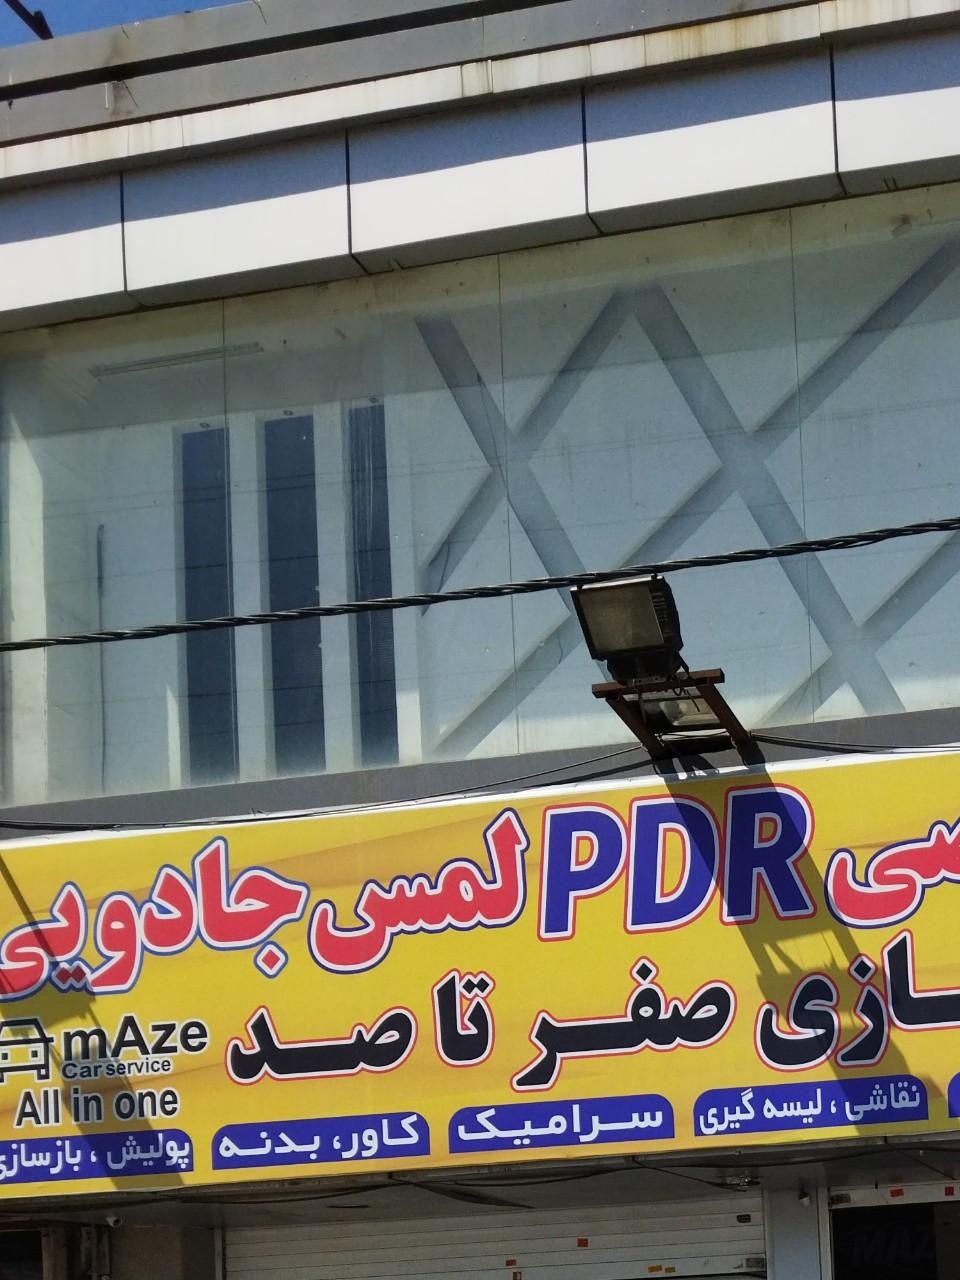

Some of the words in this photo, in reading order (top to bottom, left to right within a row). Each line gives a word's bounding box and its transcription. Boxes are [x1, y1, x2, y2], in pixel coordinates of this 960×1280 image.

[539, 782, 817, 941] PDR
[310, 807, 530, 974] لمس
[0, 836, 309, 1003] جادویی
[63, 1015, 208, 1062] mAze
[433, 969, 496, 1067] تا
[511, 956, 738, 1092] صفر
[62, 1062, 102, 1079] Car
[105, 1057, 171, 1076] service
[225, 1006, 418, 1085] صد
[15, 1088, 60, 1127] All
[73, 1087, 103, 1123] in
[114, 1088, 178, 1120] one
[457, 1104, 663, 1145] سرامیک
[699, 1087, 755, 1135] گیری
[762, 1088, 821, 1124] لیسه
[218, 1133, 320, 1160] بدنه
